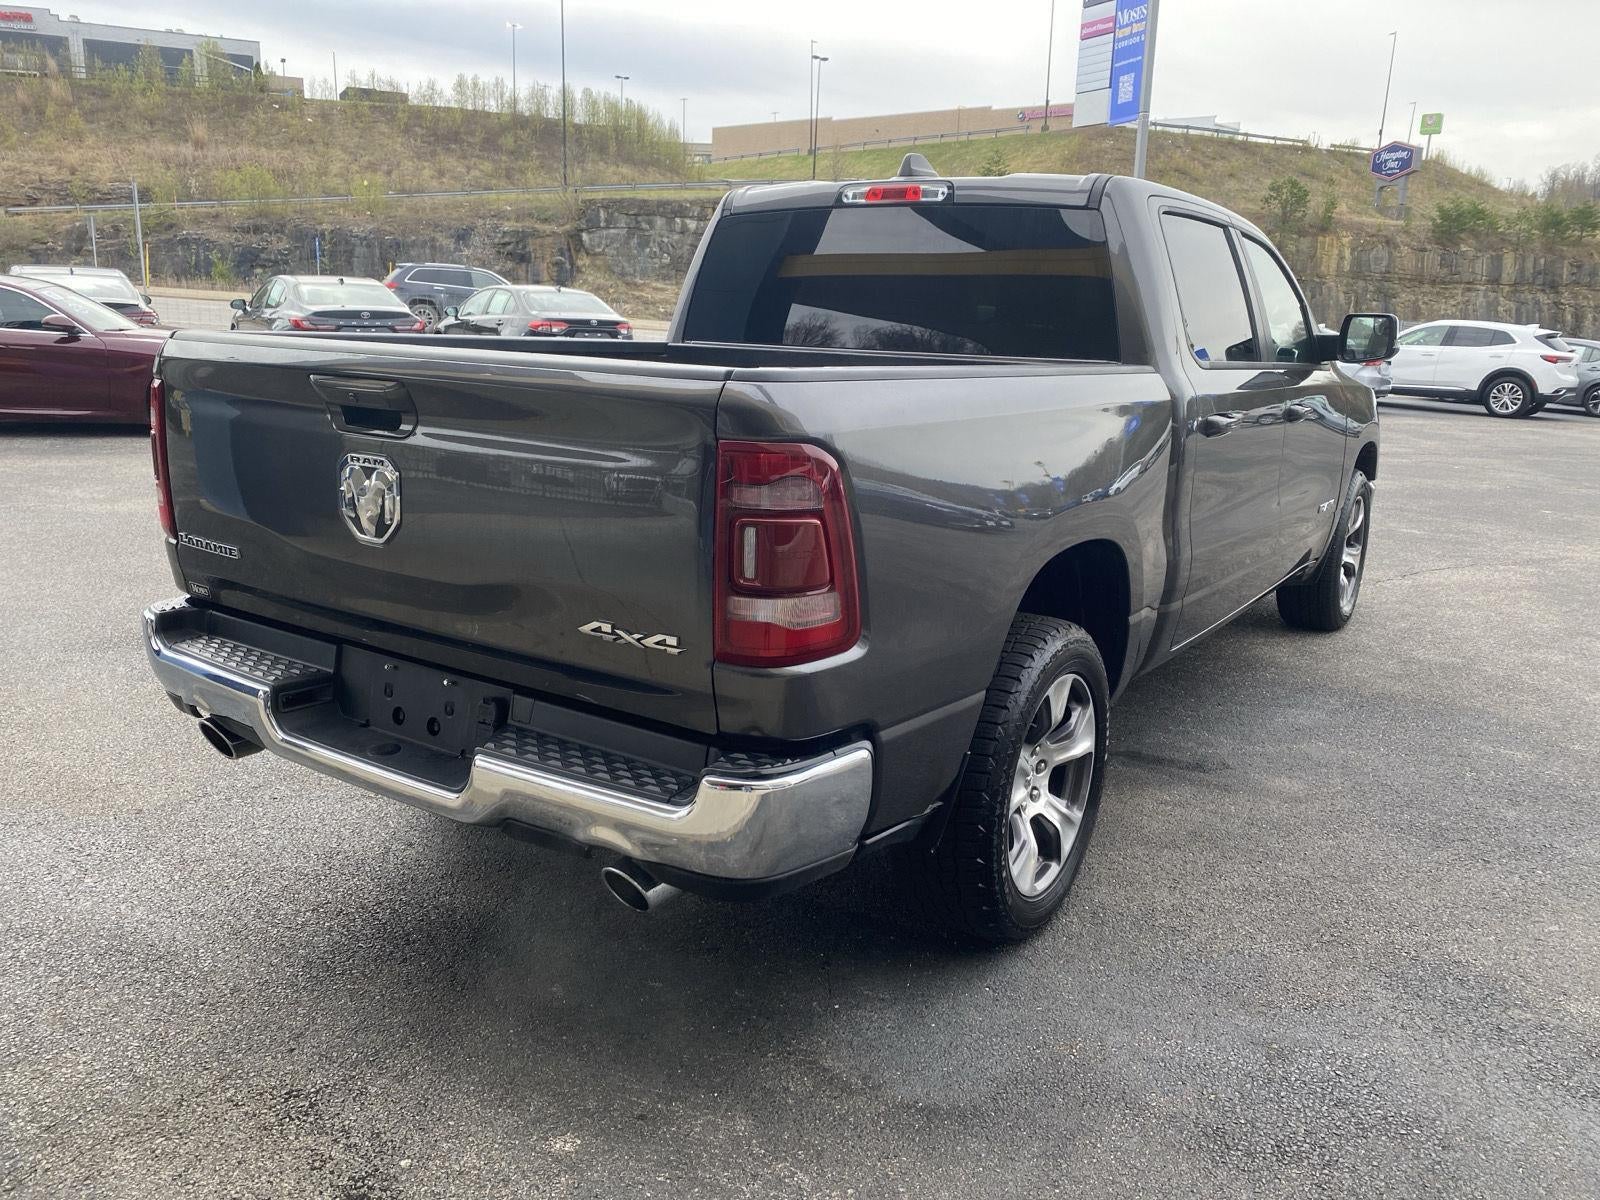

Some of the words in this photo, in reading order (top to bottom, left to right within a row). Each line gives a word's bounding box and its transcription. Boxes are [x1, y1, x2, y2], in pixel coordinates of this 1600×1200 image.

[1116, 5, 1147, 27] MOSES
[1375, 150, 1411, 163] Hampton
[349, 455, 386, 468] RAM
[178, 532, 239, 559] LARAMIE
